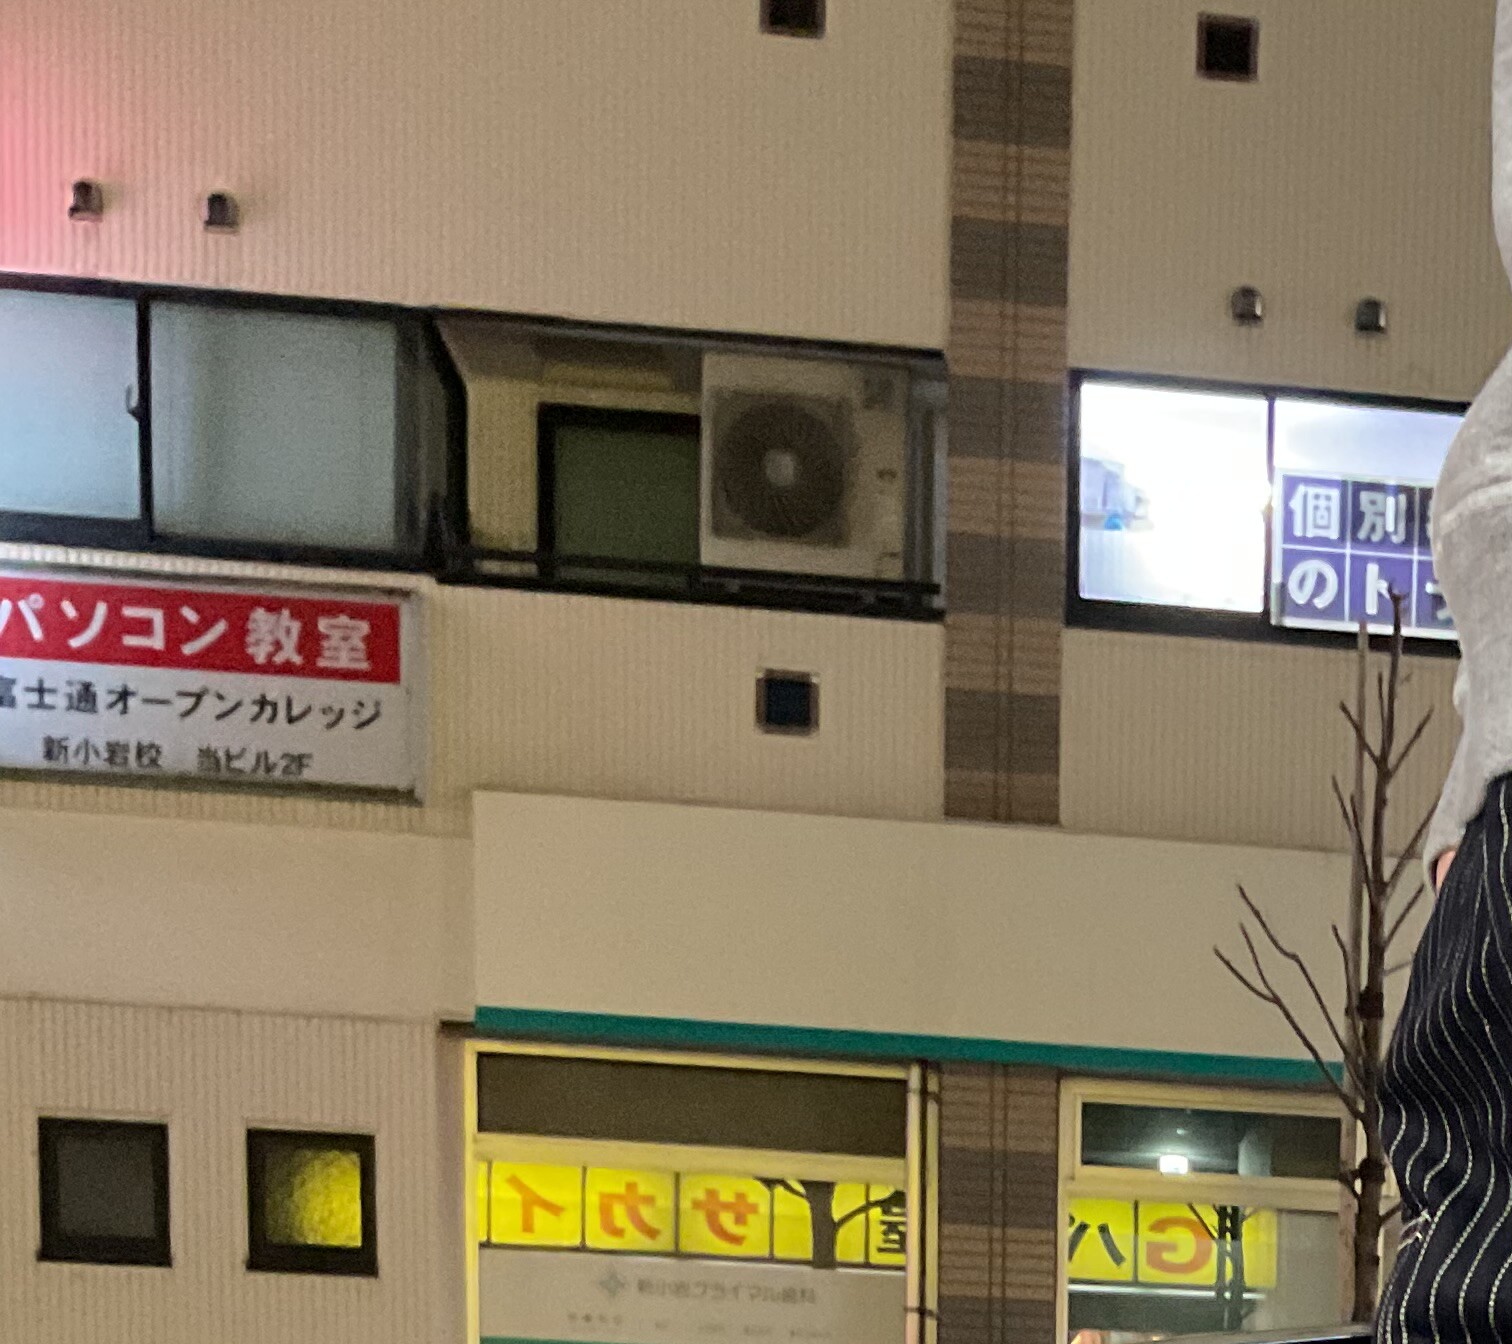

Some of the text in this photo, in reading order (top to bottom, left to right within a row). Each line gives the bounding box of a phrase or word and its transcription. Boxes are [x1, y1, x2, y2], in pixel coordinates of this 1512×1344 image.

[1289, 484, 1434, 544] 個別
[1287, 559, 1455, 621] のト
[0, 593, 371, 671] パソコン教室
[43, 735, 163, 769] 新小岩校
